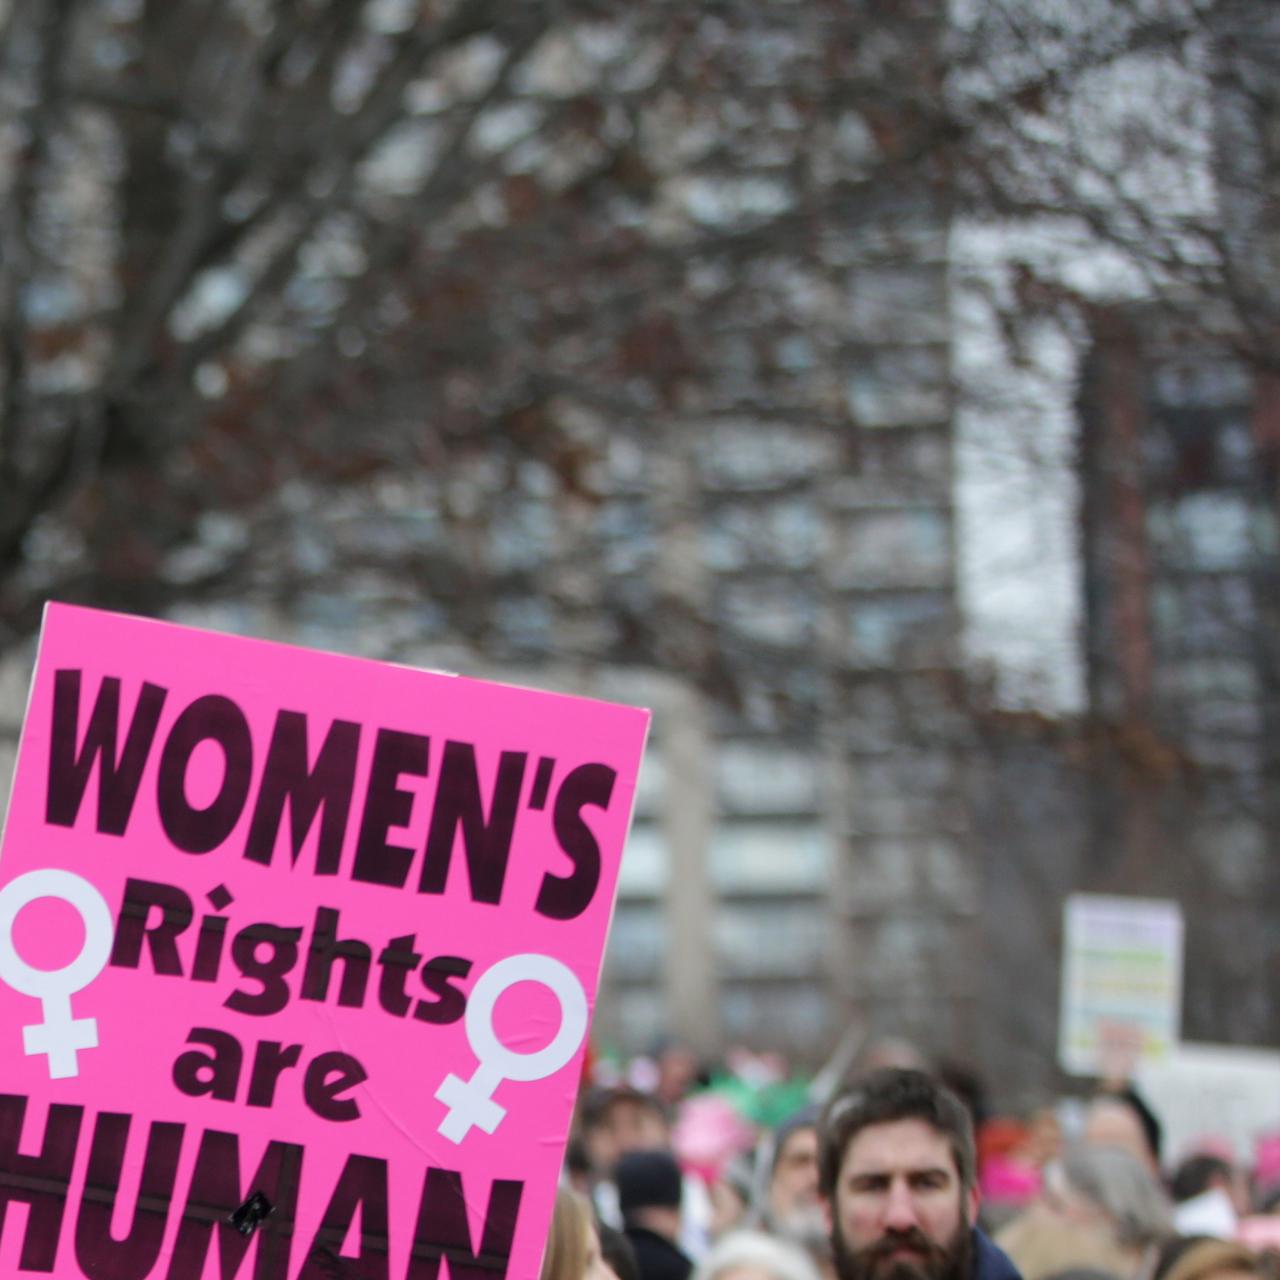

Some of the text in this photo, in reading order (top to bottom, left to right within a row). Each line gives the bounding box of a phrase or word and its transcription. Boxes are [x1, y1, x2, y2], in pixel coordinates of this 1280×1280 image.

[45, 669, 617, 922] WOMEN'S
[109, 877, 473, 1025] Rights
[172, 1027, 368, 1122] are
